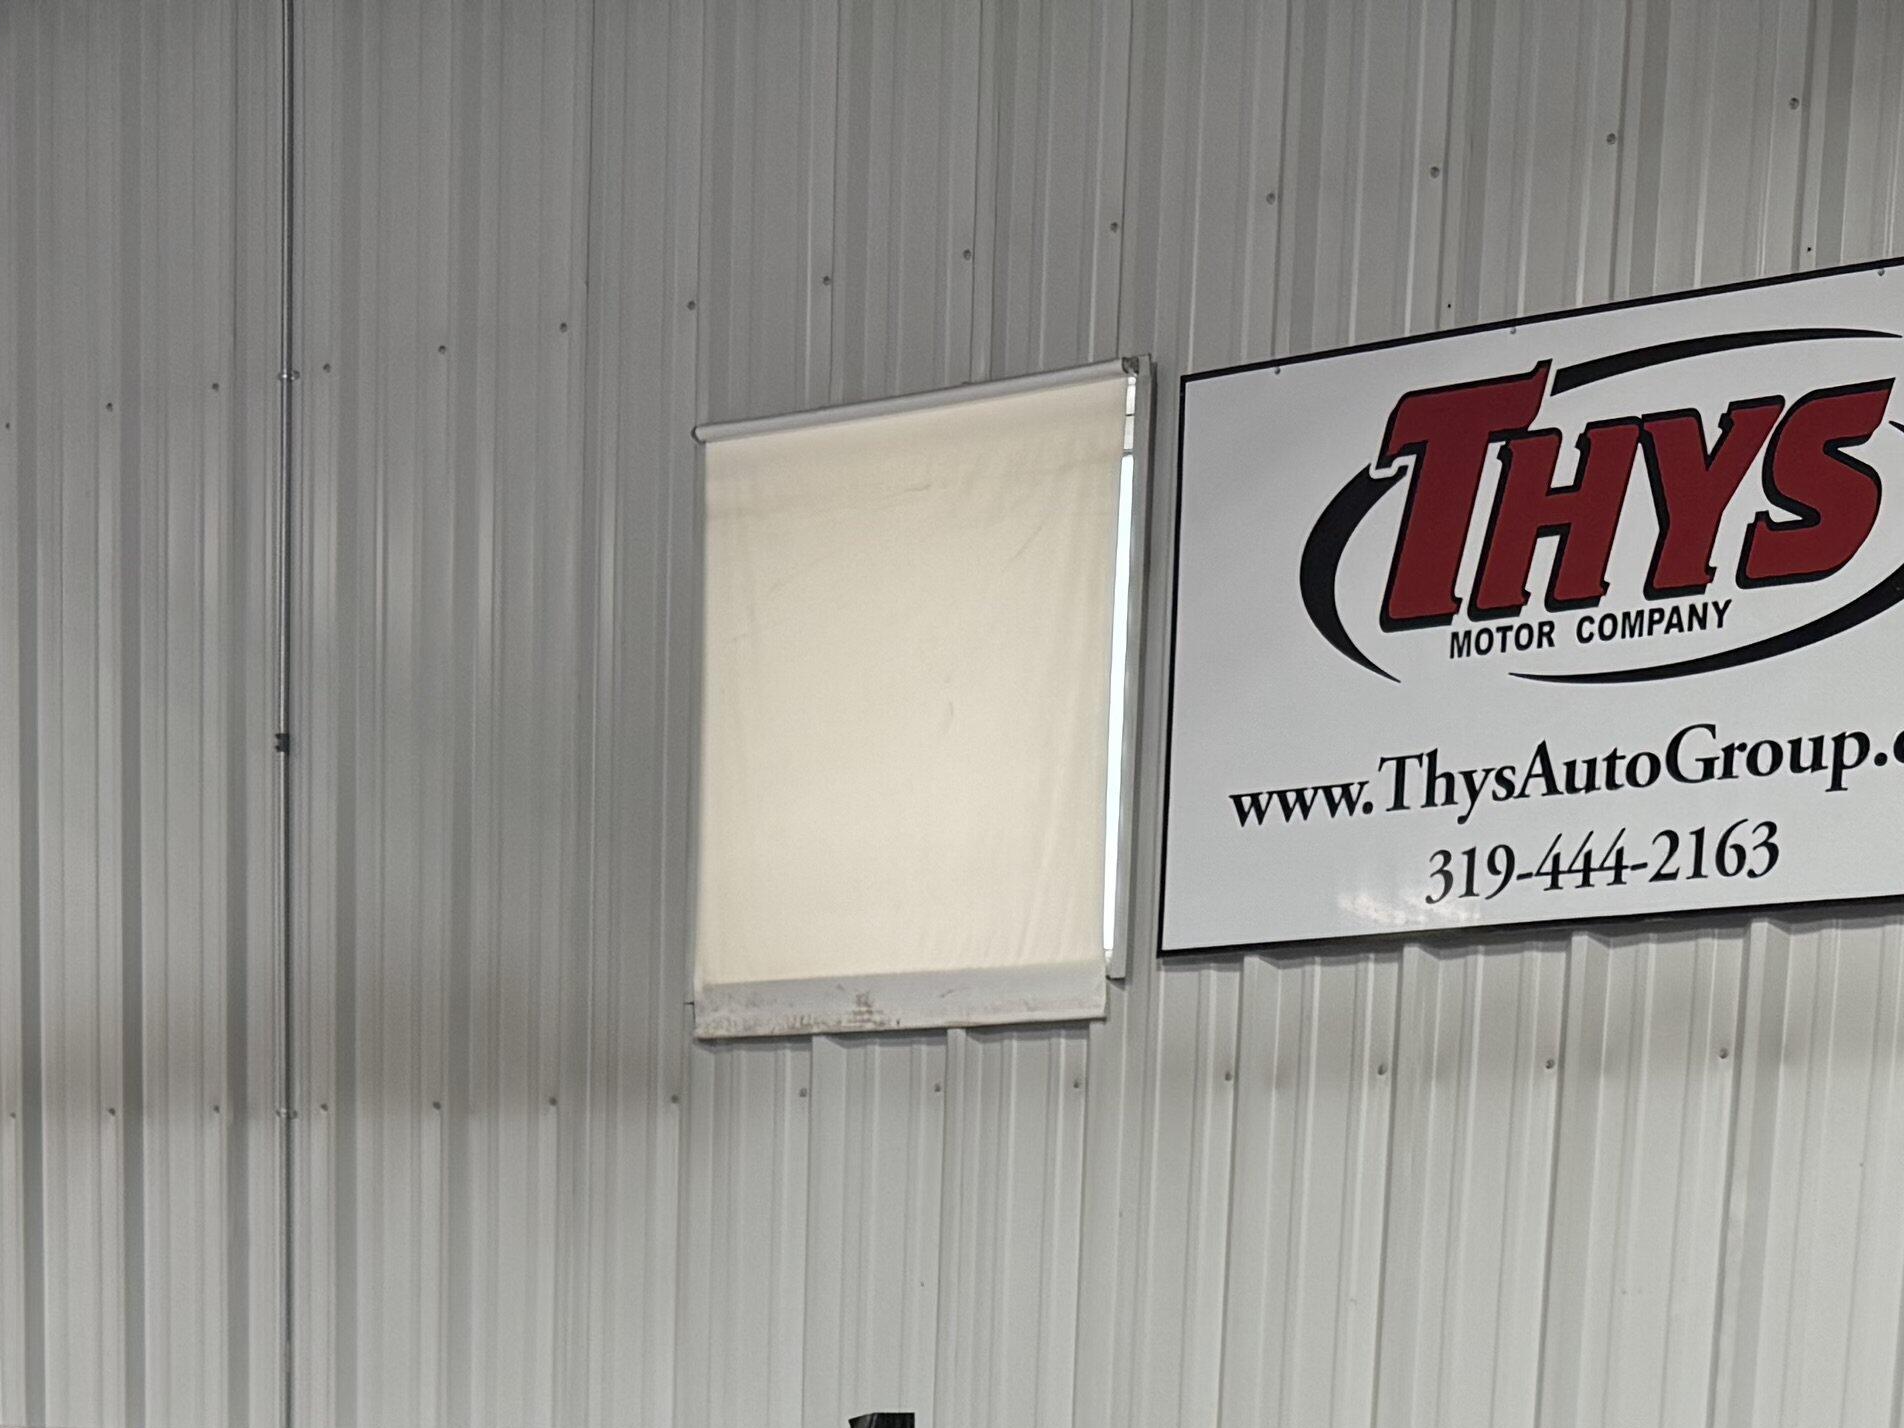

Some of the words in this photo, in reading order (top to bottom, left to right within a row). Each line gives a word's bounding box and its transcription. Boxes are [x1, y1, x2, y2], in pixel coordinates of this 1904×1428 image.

[1379, 358, 1895, 632] THYS
[1449, 619, 1556, 659] MOTOR
[1575, 598, 1733, 644] COMPANY
[1424, 818, 1781, 905] 319-444-2163
